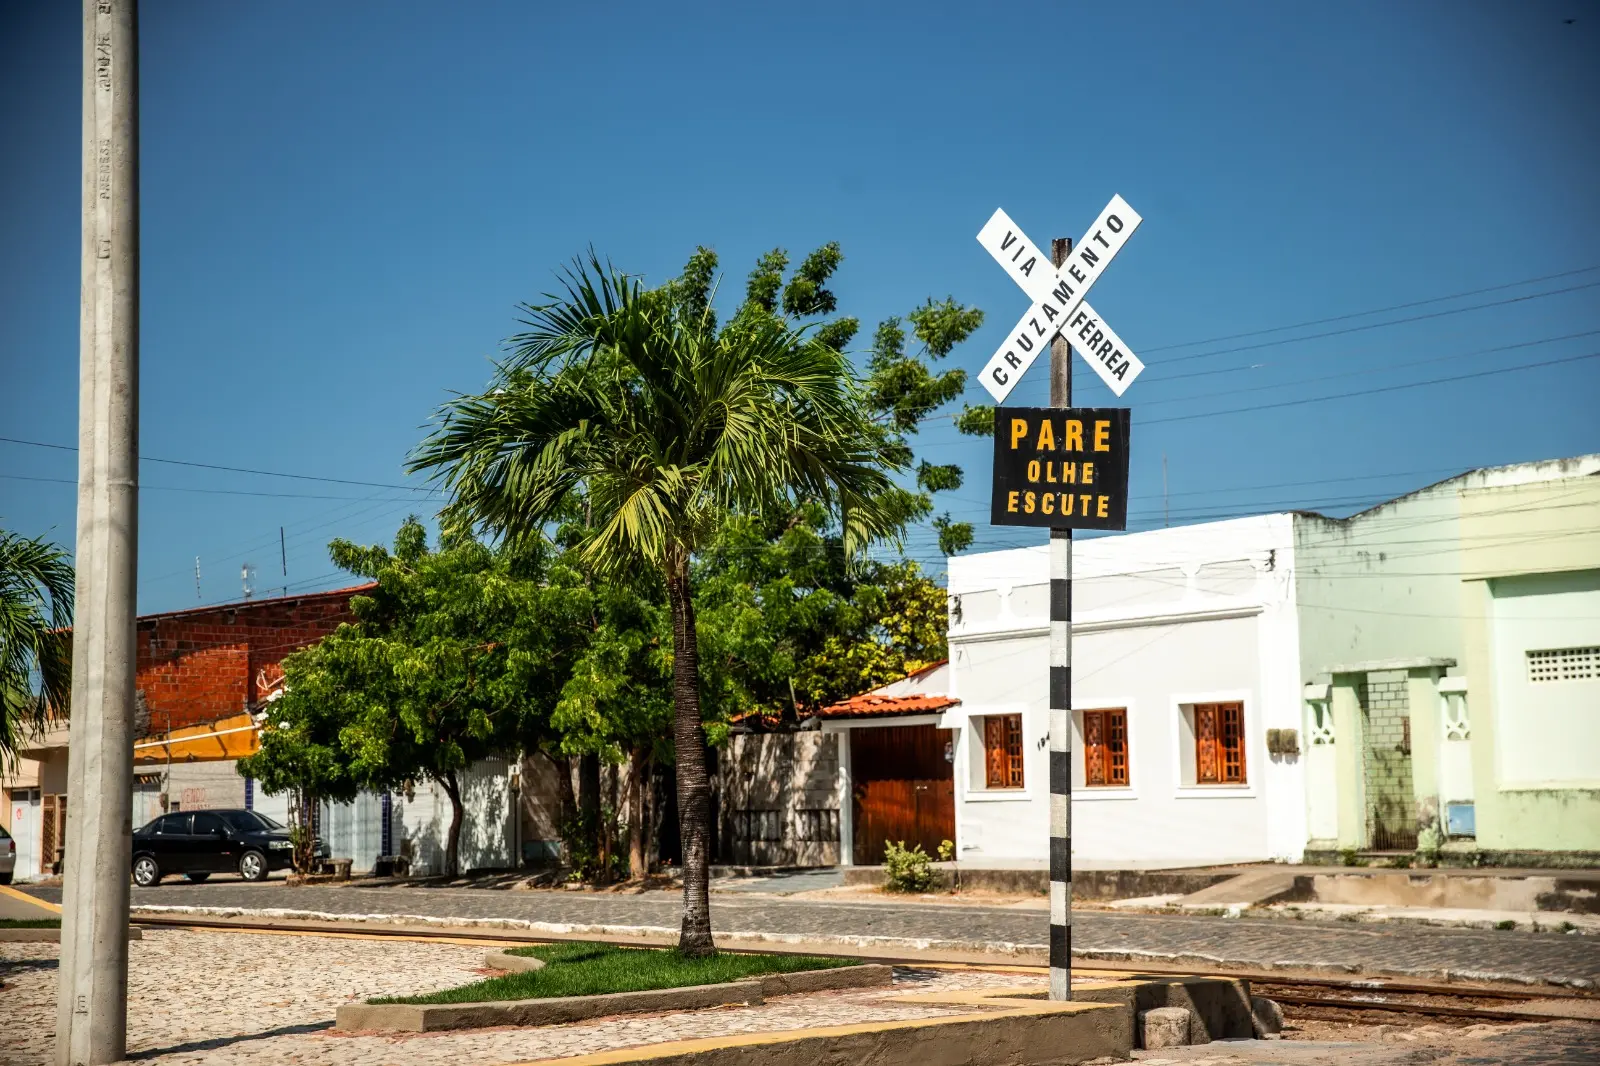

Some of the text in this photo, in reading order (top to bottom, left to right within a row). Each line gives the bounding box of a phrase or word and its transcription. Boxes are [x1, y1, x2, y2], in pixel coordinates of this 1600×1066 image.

[992, 214, 1124, 386] CRUZAMENTO
[1000, 230, 1131, 381] VIA FÉRREA
[1010, 418, 1111, 452] PARE
[1027, 460, 1094, 484] OLHE
[1007, 491, 1110, 518] ESCUTE
